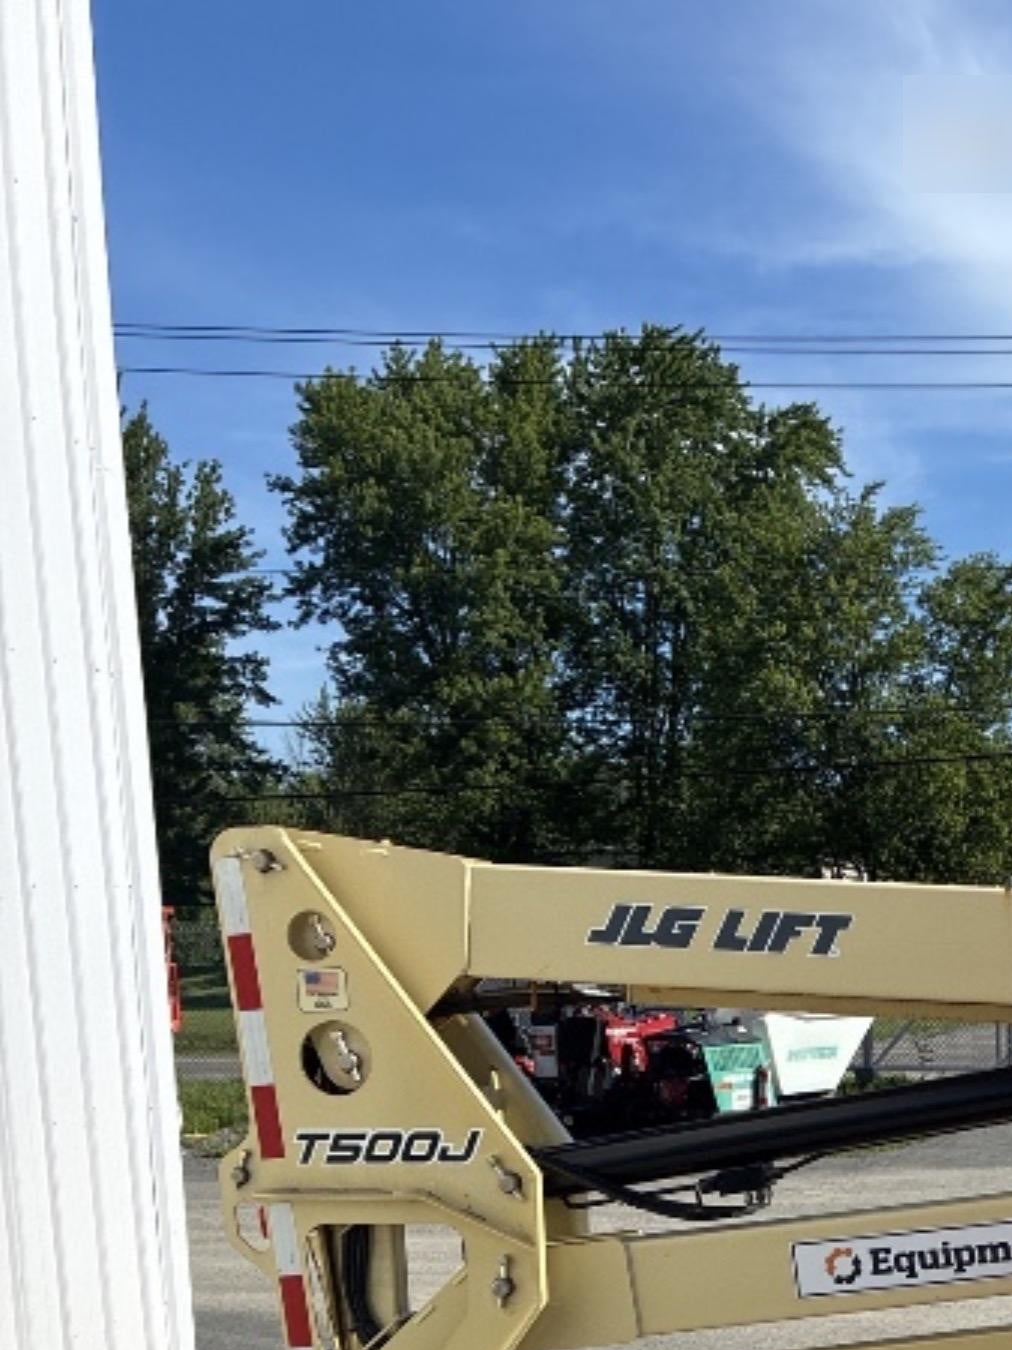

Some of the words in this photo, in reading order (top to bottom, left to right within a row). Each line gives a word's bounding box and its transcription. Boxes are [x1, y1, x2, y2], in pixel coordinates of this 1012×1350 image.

[586, 903, 707, 951] JLG
[711, 907, 854, 956] LIFT
[295, 1129, 482, 1165] T500J
